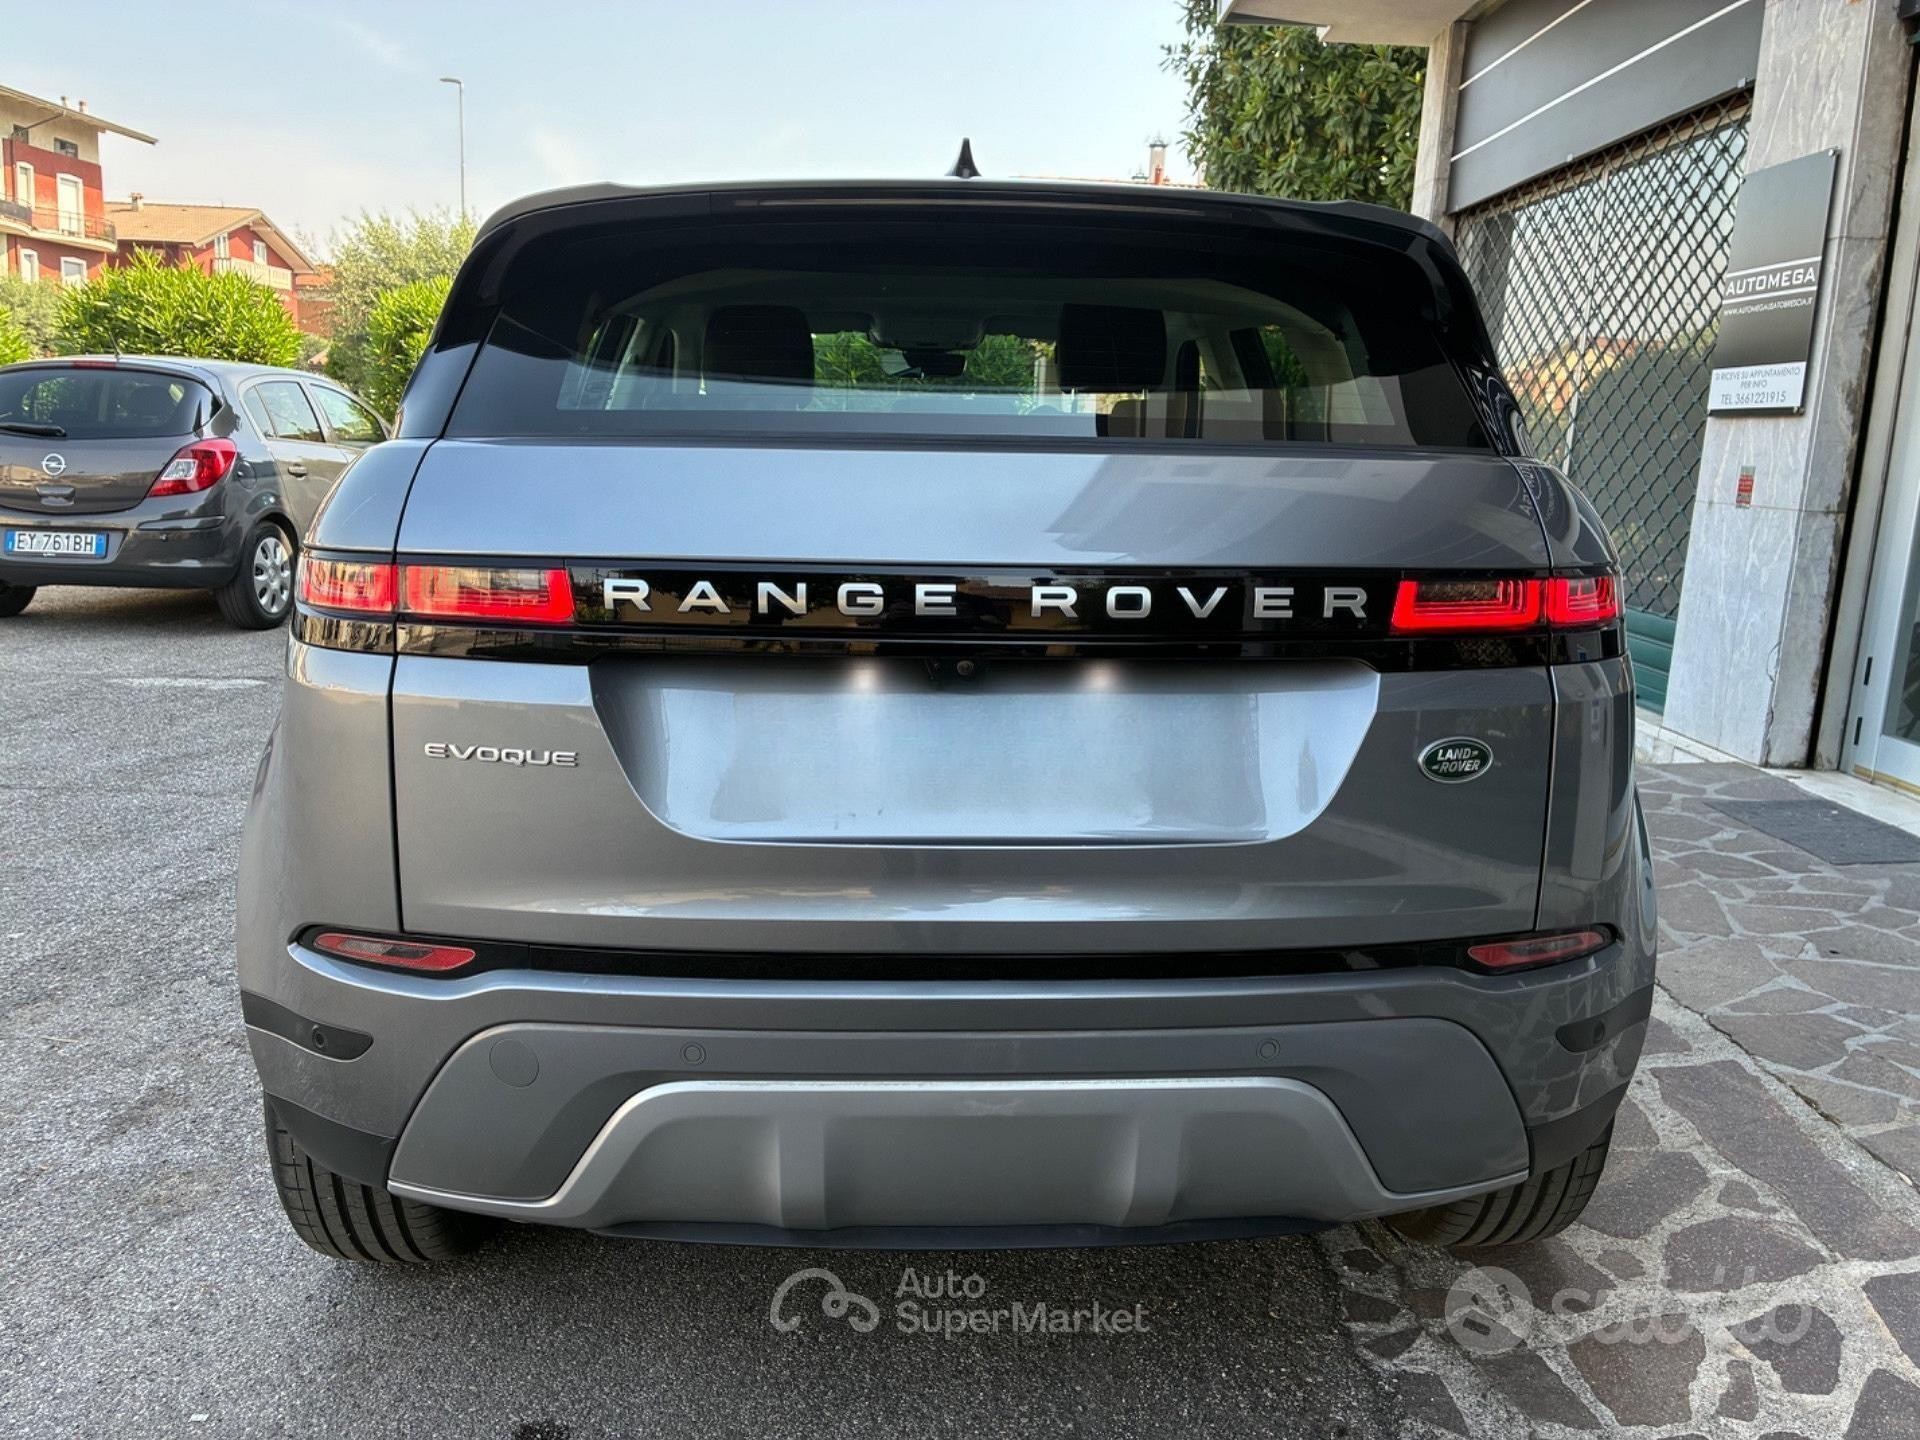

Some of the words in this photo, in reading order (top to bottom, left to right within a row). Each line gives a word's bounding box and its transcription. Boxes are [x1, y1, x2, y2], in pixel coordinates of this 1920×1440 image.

[1725, 266, 1816, 296] AUTOMEGA
[1750, 366, 1801, 378] APPUNTAMENTO
[1741, 380, 1751, 389] PER
[1735, 390, 1787, 405] 3661221915
[17, 533, 37, 550] EY
[42, 534, 94, 552] 761BH
[602, 577, 958, 617] RANGE
[1030, 585, 1369, 620] ROVER
[424, 742, 578, 768] EVOQUE
[1437, 747, 1472, 761] LAND
[1439, 758, 1481, 774] ROVER
